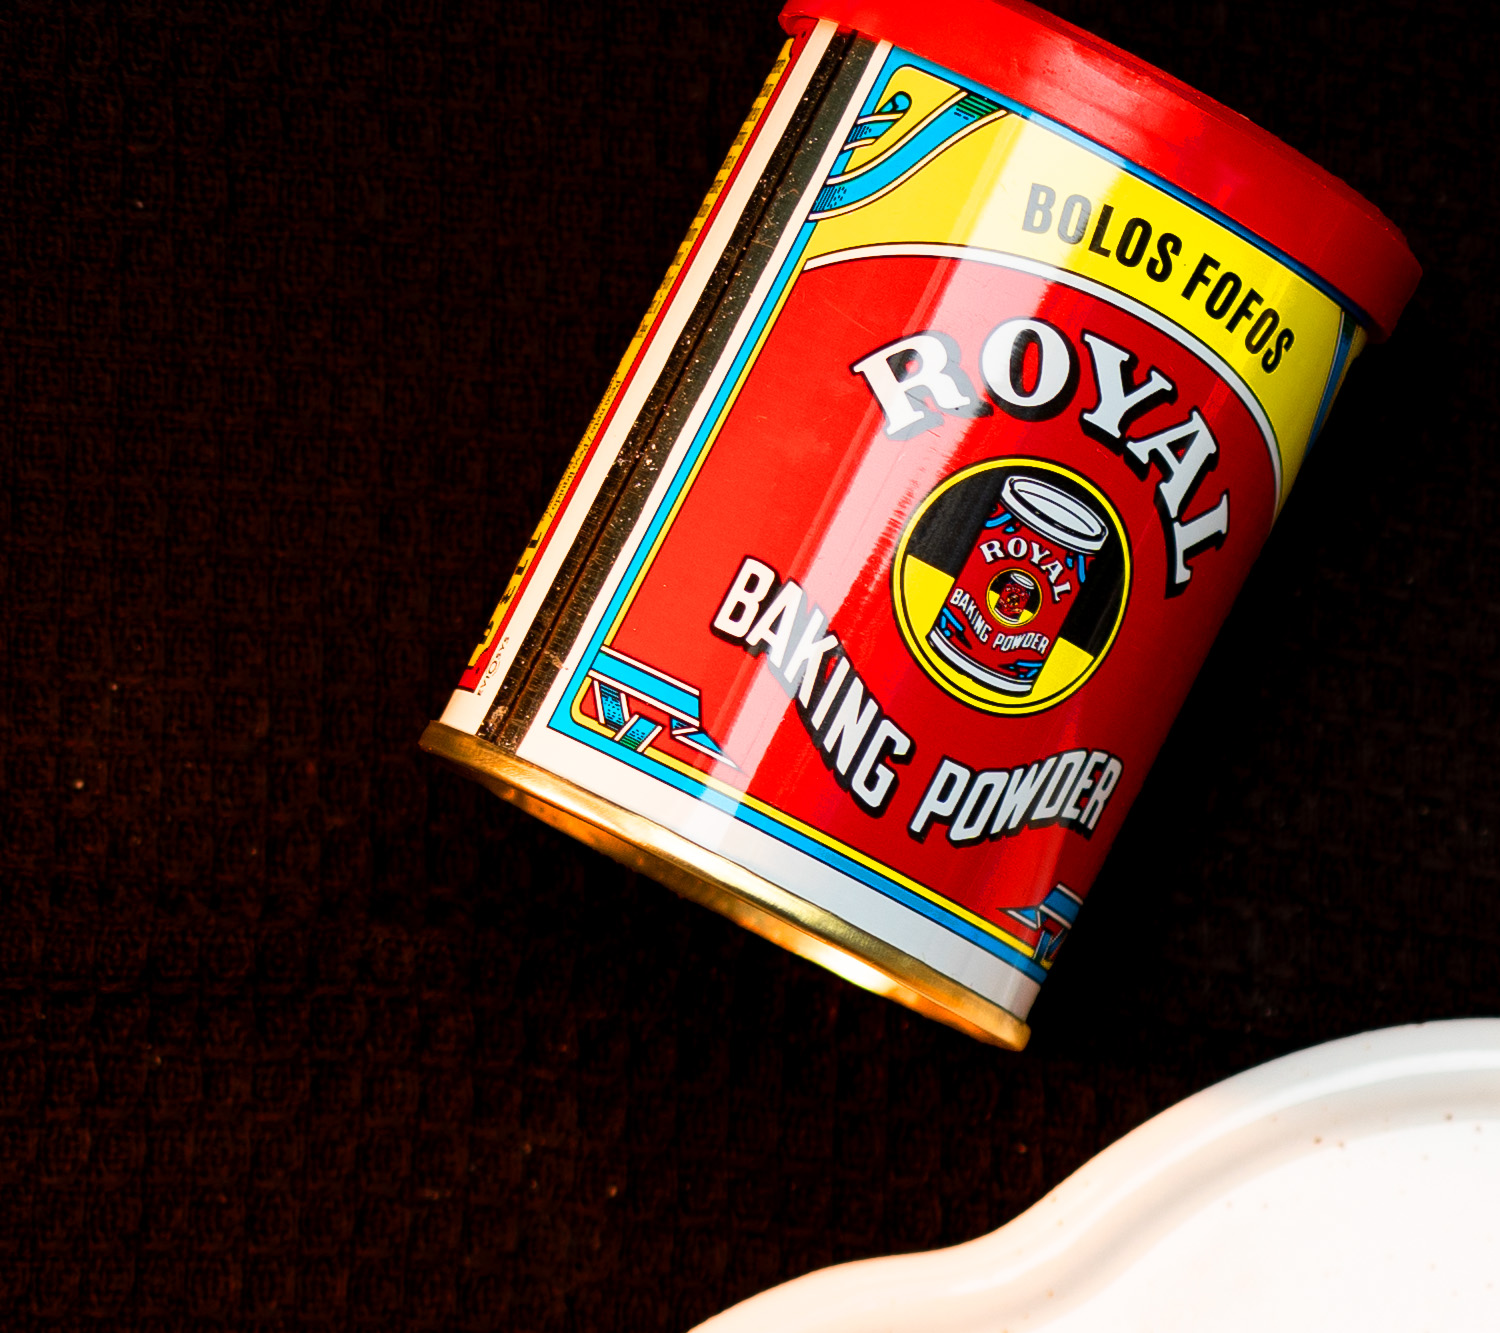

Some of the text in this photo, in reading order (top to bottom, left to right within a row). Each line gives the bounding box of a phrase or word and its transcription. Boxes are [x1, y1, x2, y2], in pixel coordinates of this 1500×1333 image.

[1021, 182, 1295, 376] BOLOS FOFOS
[852, 317, 1232, 584] ROYAL
[949, 587, 1050, 655] BAKING POWDER
[979, 537, 1072, 602] ROYAL
[714, 557, 1124, 844] BAKING POWDER
